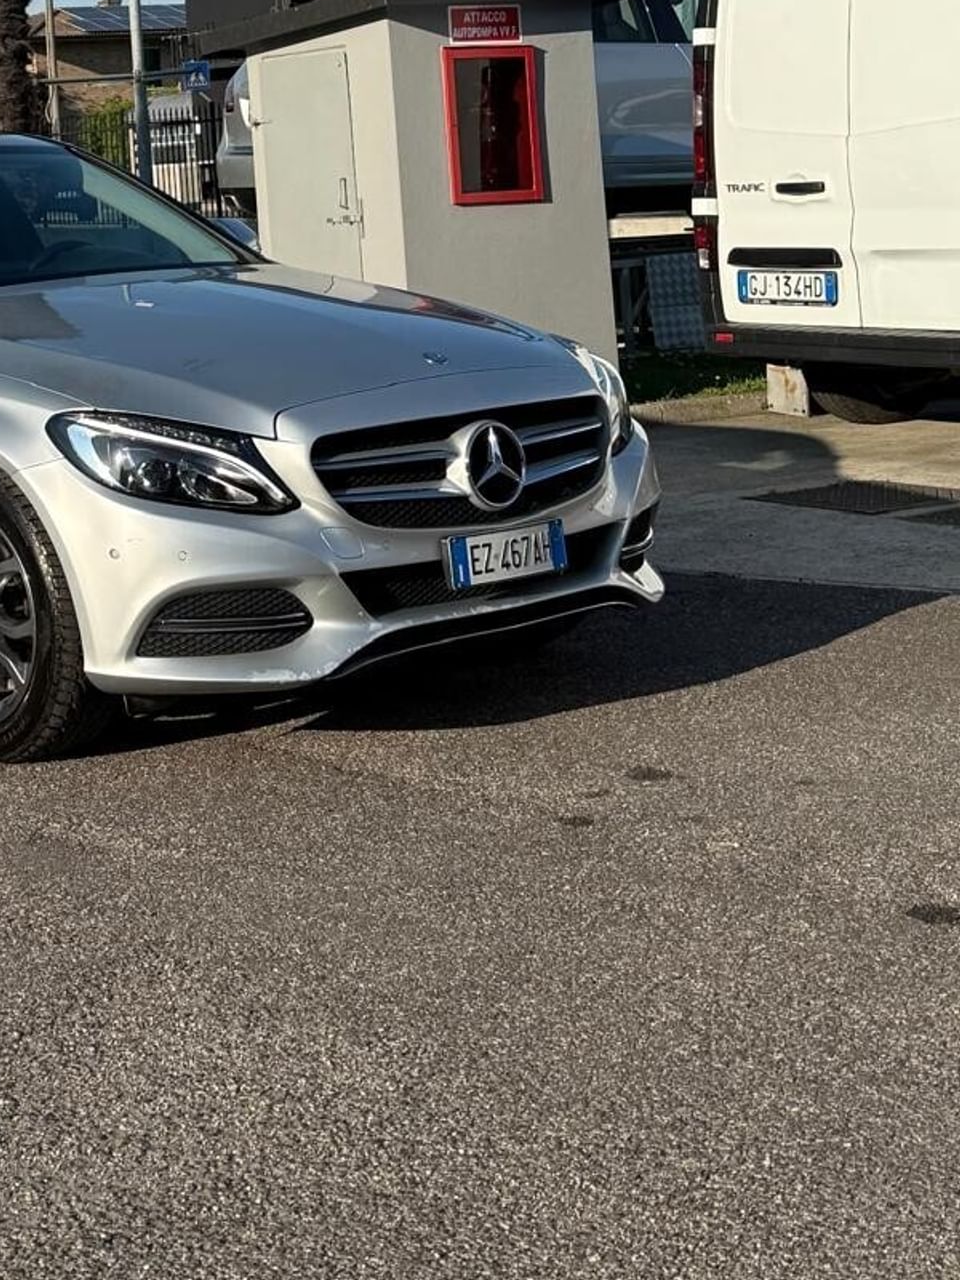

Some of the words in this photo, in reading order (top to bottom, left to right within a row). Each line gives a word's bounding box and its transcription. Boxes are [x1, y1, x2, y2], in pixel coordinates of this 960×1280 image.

[463, 10, 507, 24] ATTACCO
[452, 26, 498, 39] AUTOPOMPA
[724, 182, 765, 193] TRAFIC
[749, 275, 768, 296] GJ
[775, 275, 823, 298] 134HD
[470, 543, 495, 576] EZ
